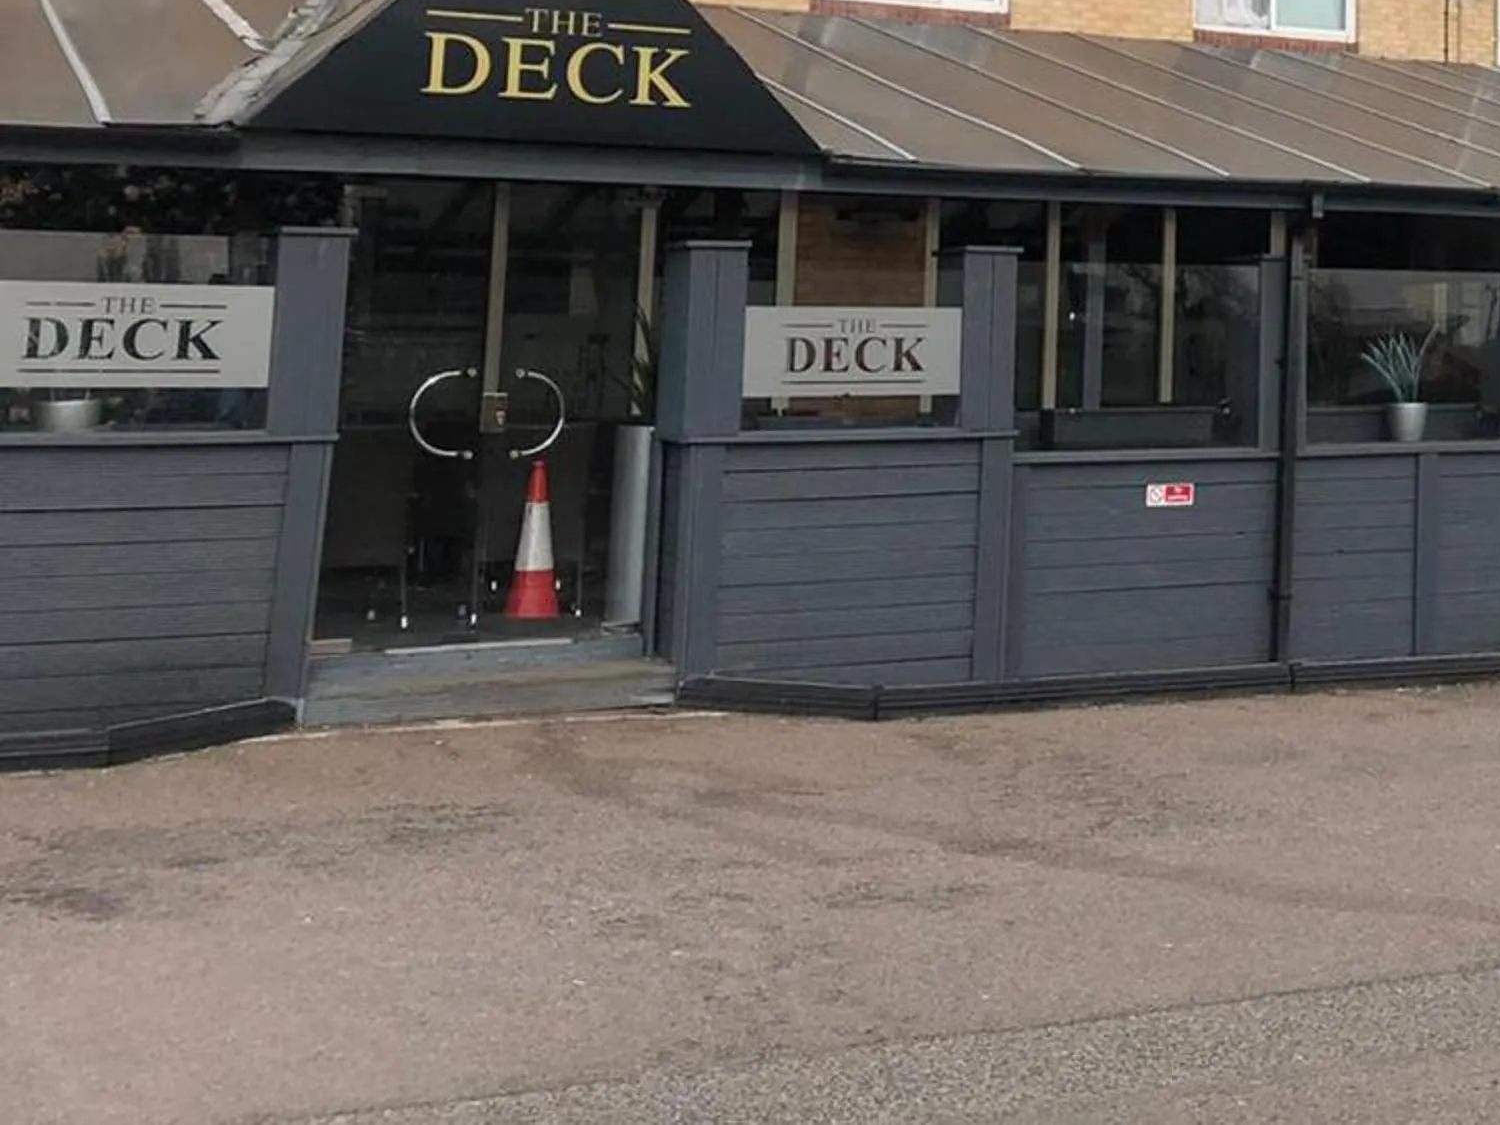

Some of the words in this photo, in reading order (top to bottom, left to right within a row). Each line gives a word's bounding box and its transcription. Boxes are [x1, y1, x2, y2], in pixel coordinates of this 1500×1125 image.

[524, 7, 603, 37] THE
[419, 30, 692, 108] DECK
[102, 297, 157, 315] THE
[21, 315, 225, 362] DECK
[837, 317, 877, 334] THE
[784, 335, 927, 374] DECK
